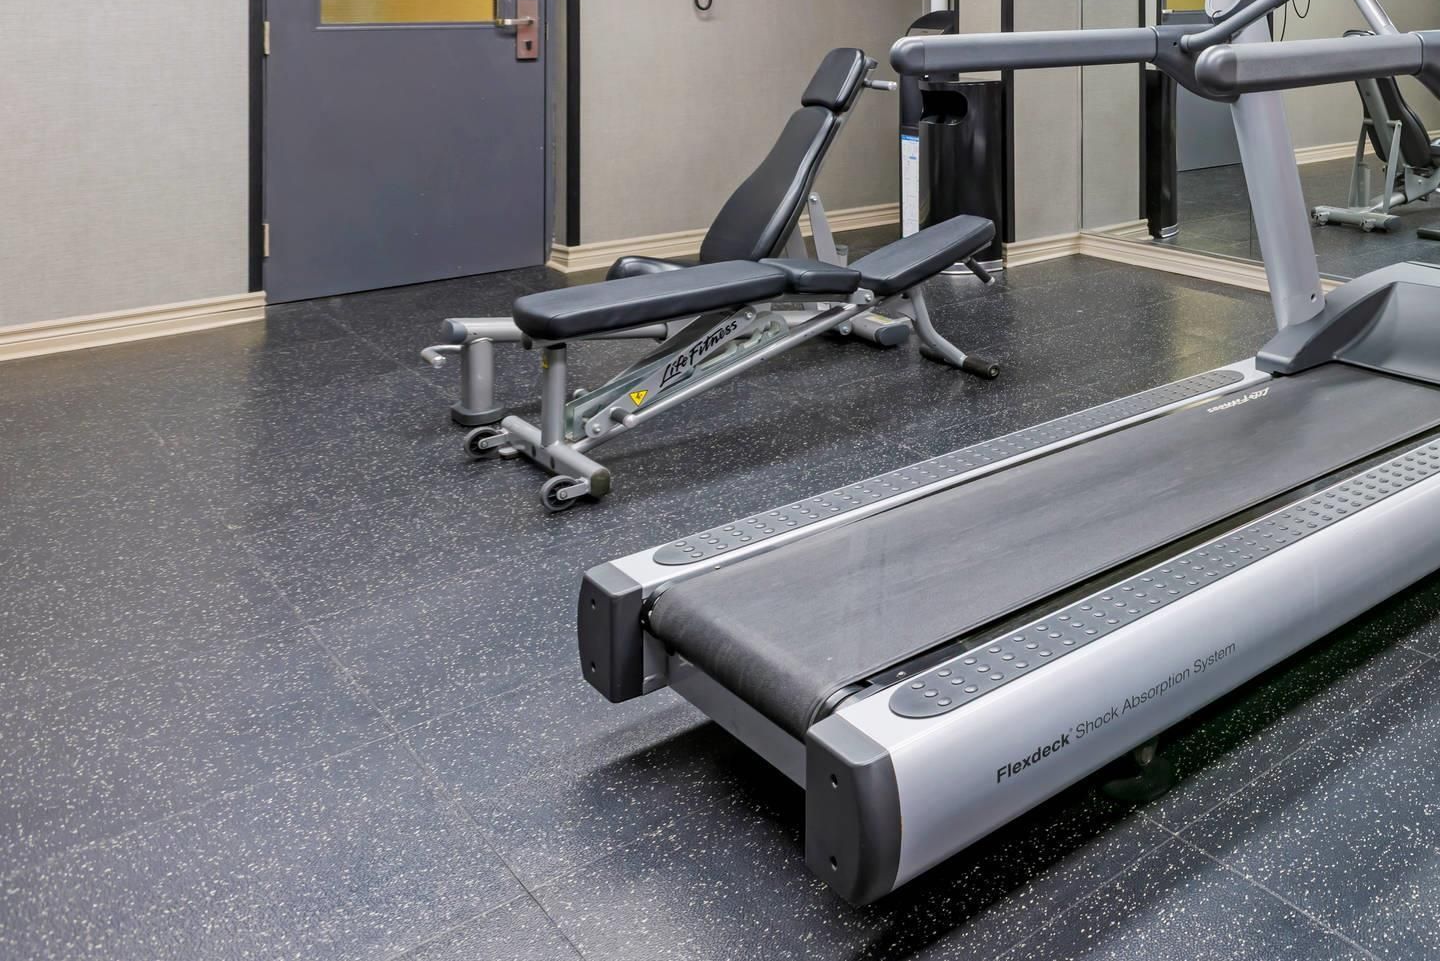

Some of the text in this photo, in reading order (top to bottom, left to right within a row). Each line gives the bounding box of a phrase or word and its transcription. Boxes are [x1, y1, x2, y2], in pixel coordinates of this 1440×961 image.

[660, 320, 737, 388] Life Fitness
[995, 640, 1237, 785] Flexdeck Shock Absorption System
